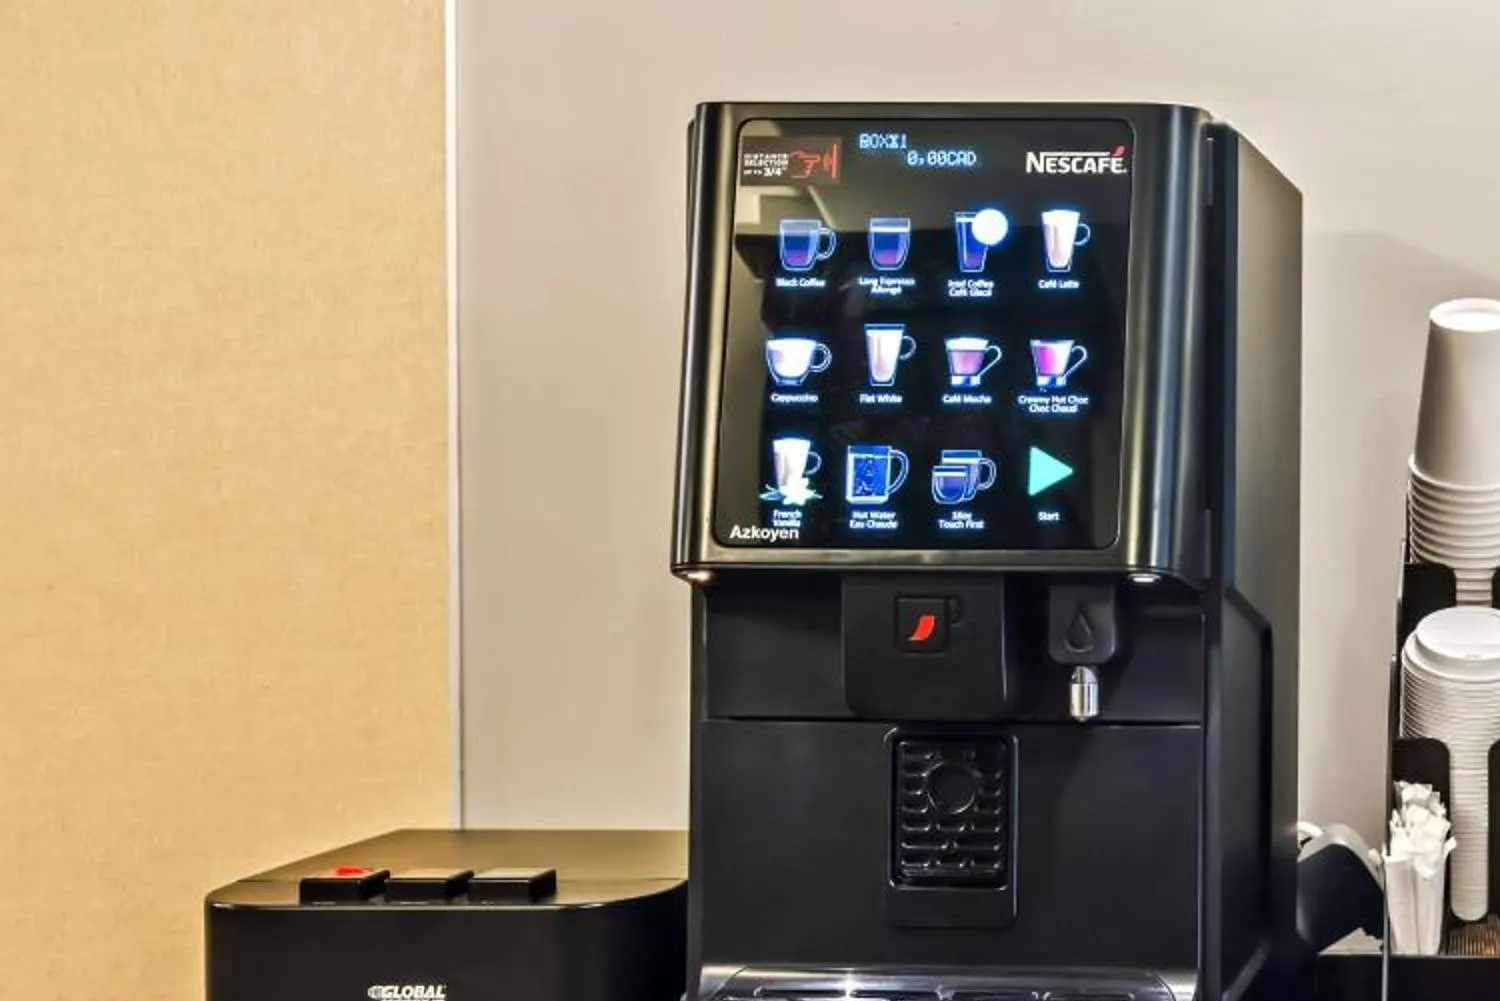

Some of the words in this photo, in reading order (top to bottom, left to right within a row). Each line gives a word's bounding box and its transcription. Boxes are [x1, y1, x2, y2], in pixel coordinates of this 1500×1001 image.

[799, 277, 825, 288] Coffee
[967, 279, 994, 289] Coffee
[859, 393, 875, 404] Flat
[877, 393, 903, 404] White
[964, 394, 992, 404] Mocha
[773, 509, 802, 519] French
[1038, 511, 1060, 521] Start
[938, 519, 964, 529] Touch
[965, 519, 985, 529] First
[729, 524, 799, 542] Azkoyen
[381, 984, 446, 999] GLOBAL
